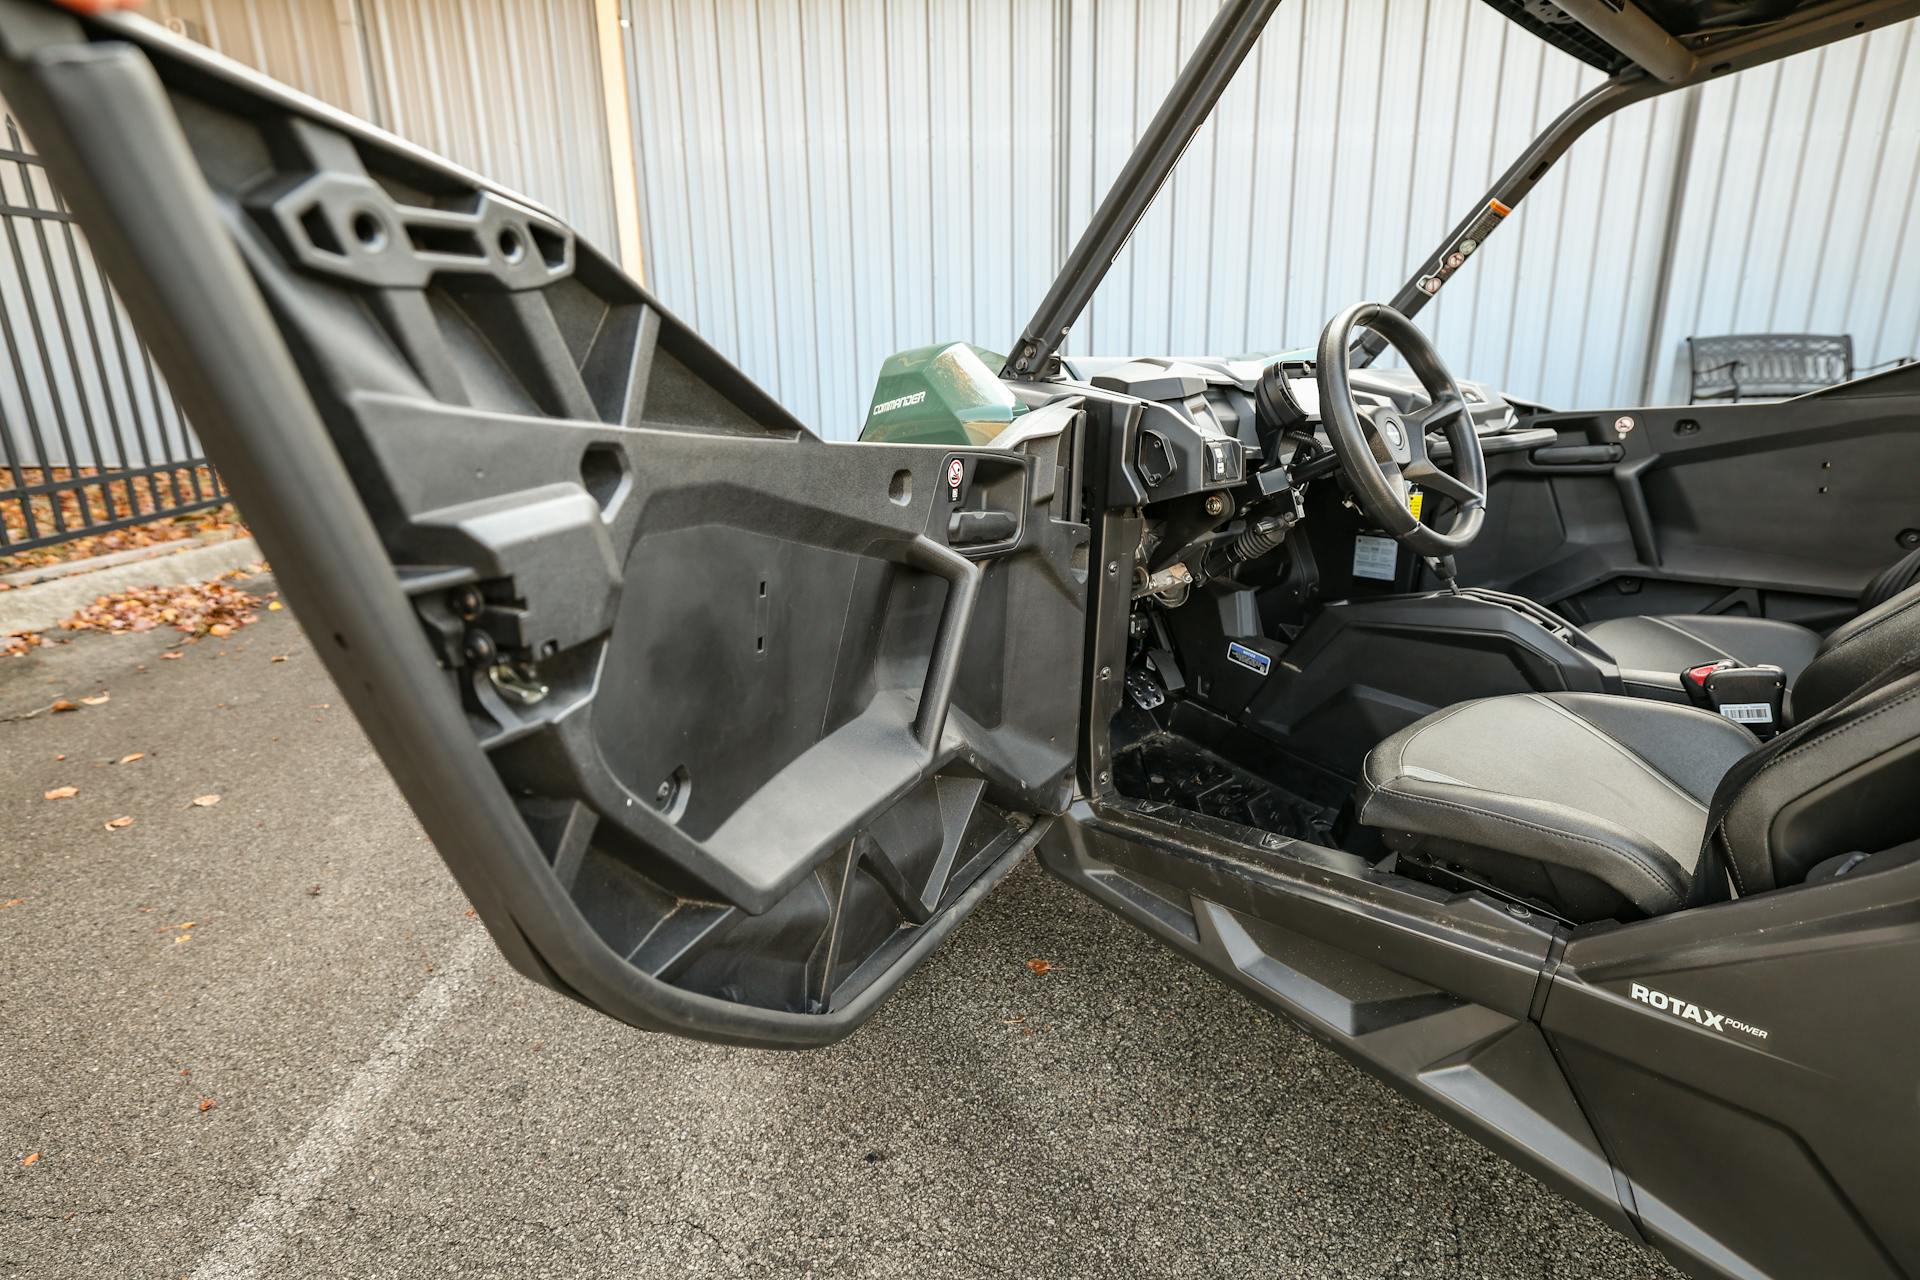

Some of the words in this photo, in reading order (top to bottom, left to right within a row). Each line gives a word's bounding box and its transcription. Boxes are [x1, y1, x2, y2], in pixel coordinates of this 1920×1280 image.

[873, 391, 926, 416] COMMANDER
[1631, 983, 1725, 1032] ROTAX
[1724, 1017, 1768, 1039] POWER
